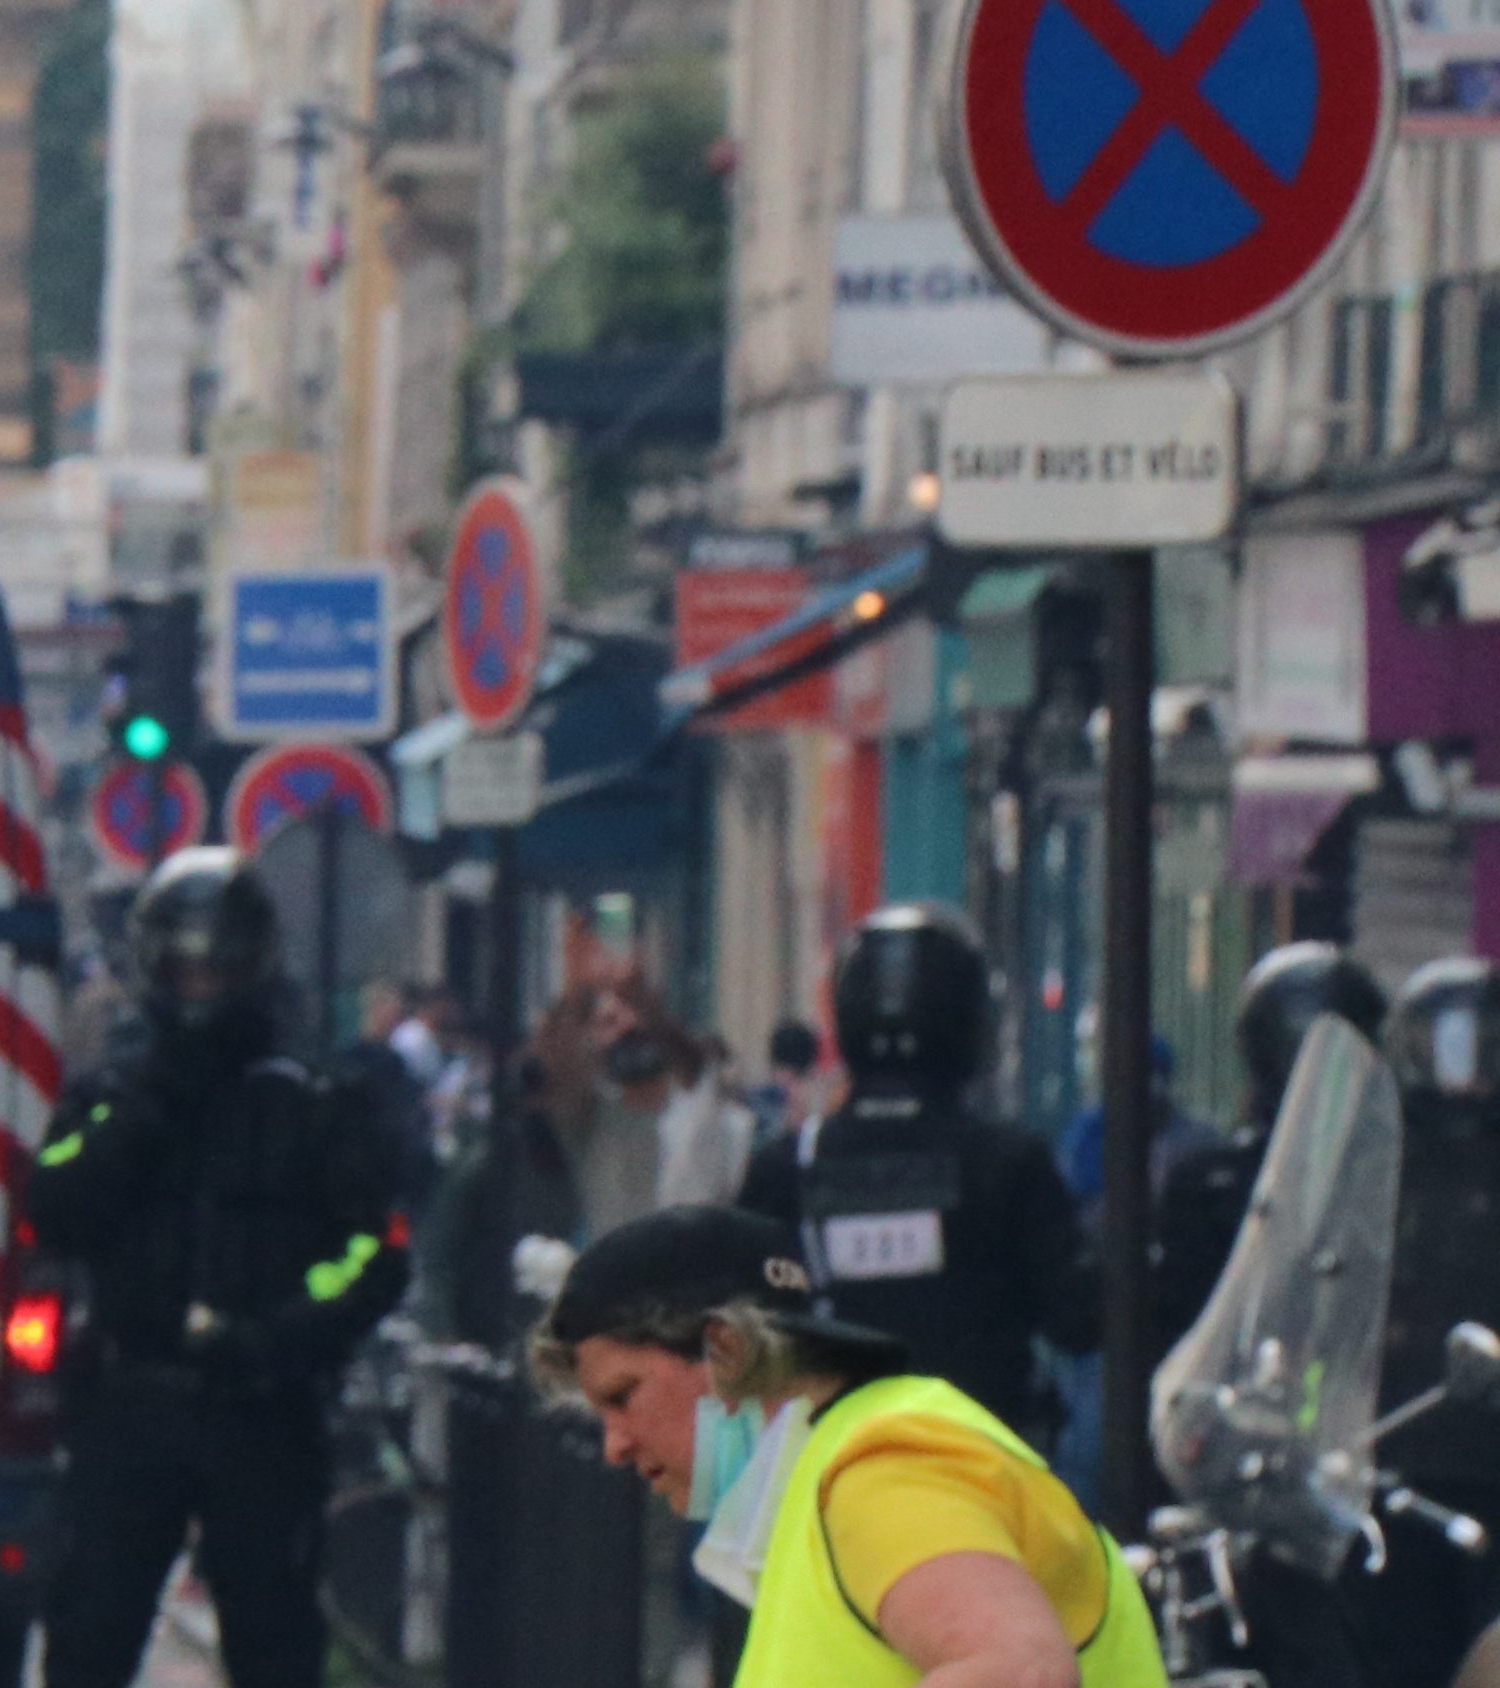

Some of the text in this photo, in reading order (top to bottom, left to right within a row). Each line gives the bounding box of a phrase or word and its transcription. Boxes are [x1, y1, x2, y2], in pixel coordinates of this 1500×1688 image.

[952, 438, 1219, 481] SAUF BUS ET VÉLO
